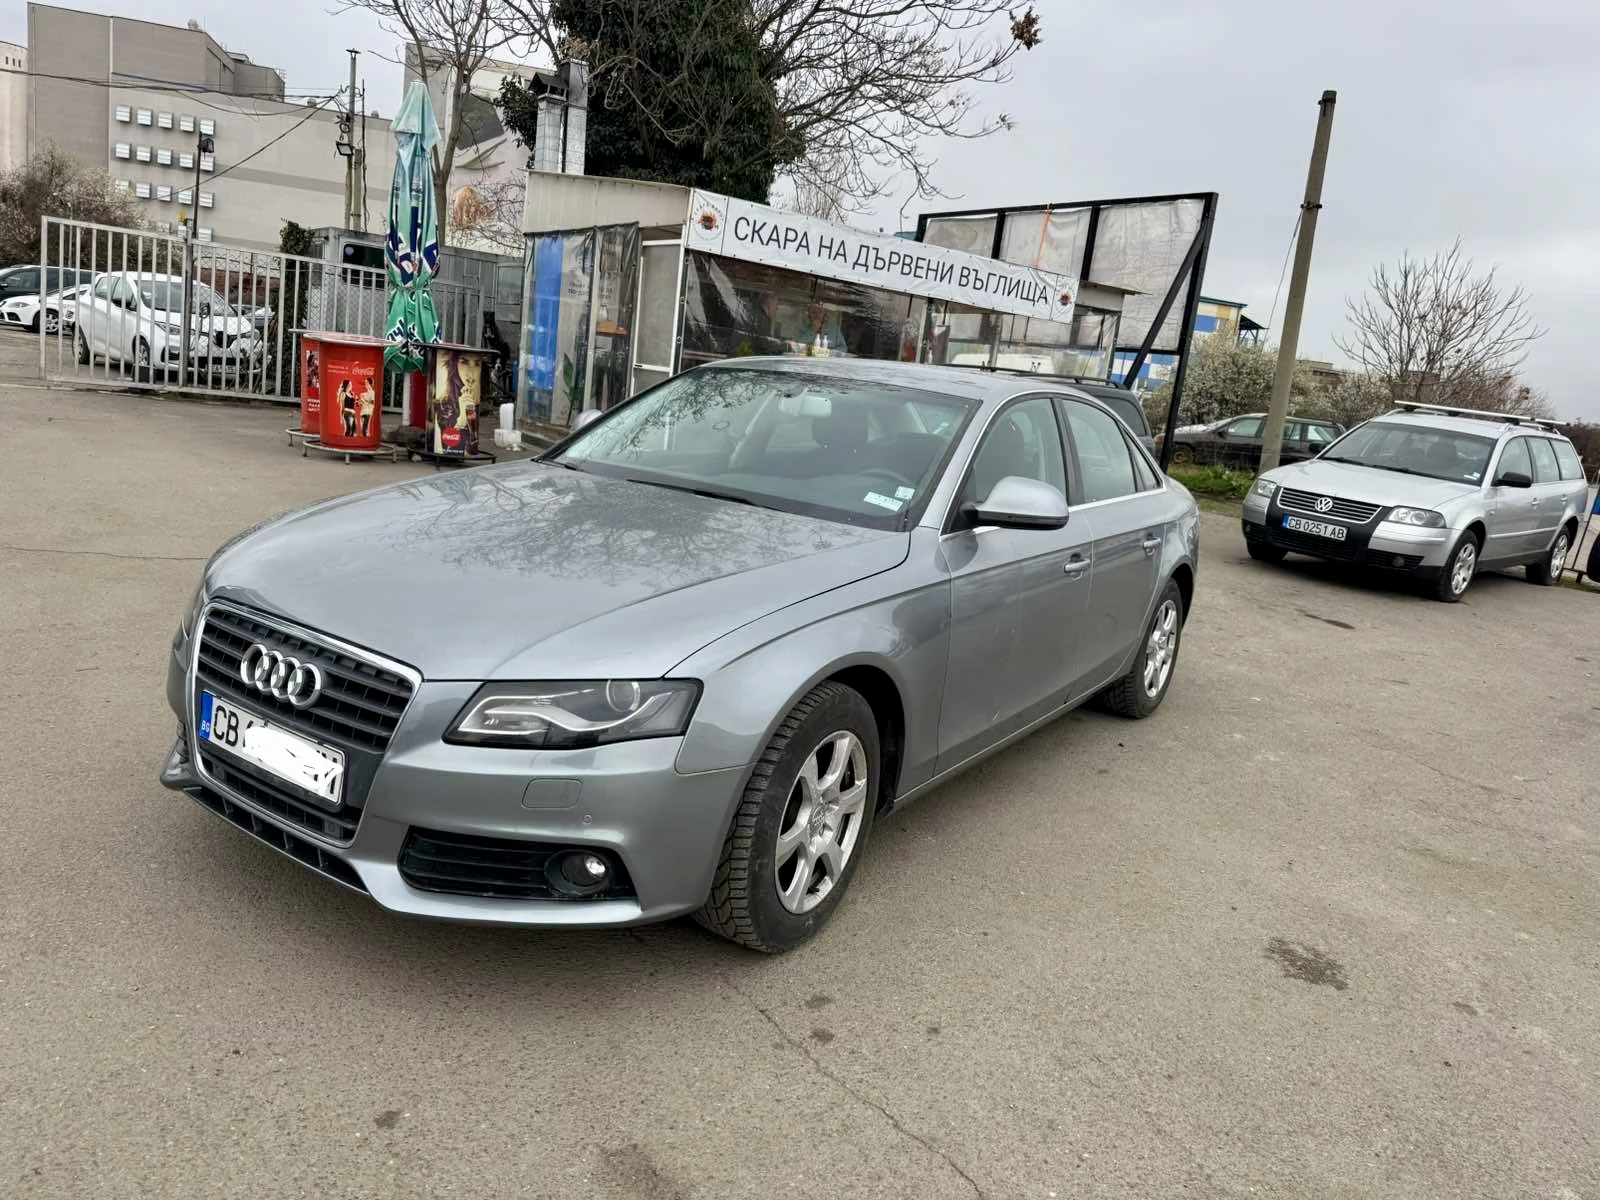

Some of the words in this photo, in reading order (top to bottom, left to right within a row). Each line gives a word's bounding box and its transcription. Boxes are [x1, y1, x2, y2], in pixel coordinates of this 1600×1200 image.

[734, 216, 810, 256] СКАРА
[817, 234, 848, 263] НА
[852, 244, 955, 284] ДЪРВЕНИ
[958, 266, 1048, 306] ВЪГЛИЩА
[1303, 521, 1328, 536] 0251
[1330, 527, 1345, 539] AB
[213, 705, 239, 747] CB
